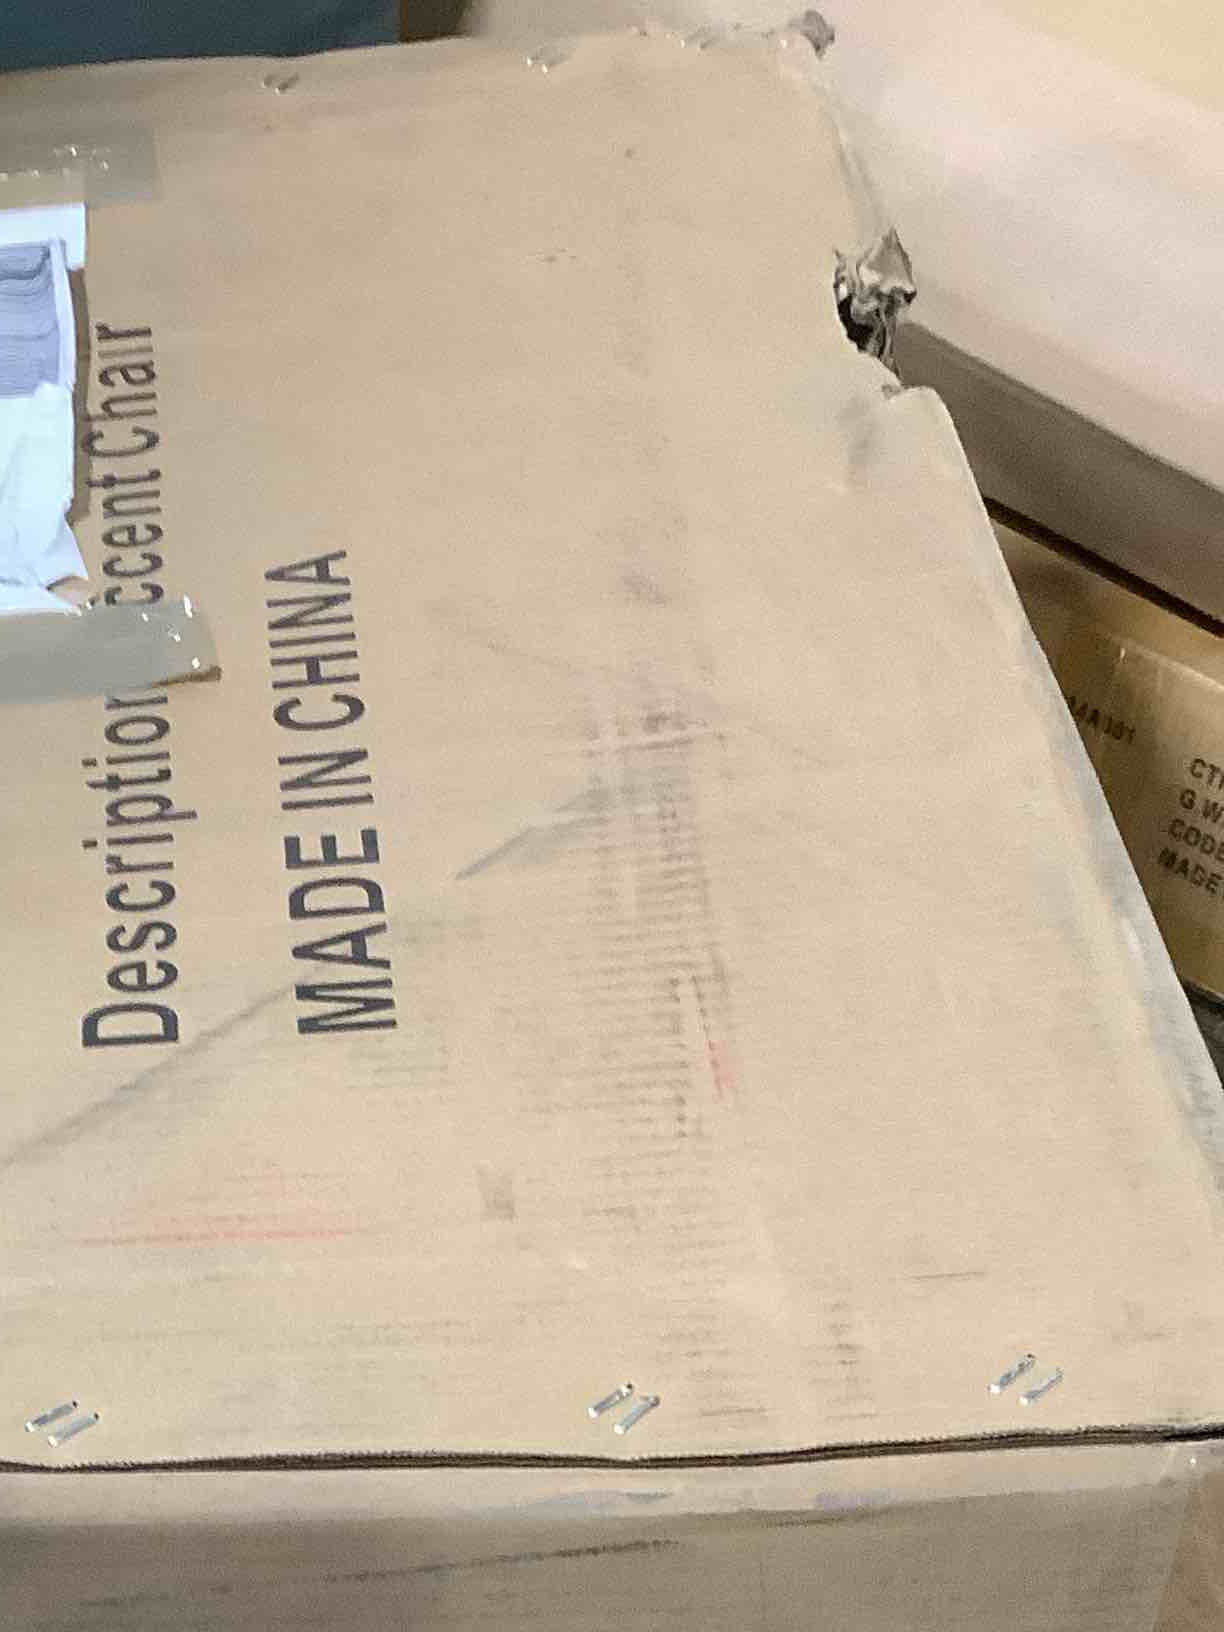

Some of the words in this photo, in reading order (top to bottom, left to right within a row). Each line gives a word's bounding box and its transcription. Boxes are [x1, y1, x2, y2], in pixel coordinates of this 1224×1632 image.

[82, 322, 161, 458] Chair
[85, 468, 164, 606] ccent
[264, 550, 366, 731] CHINA
[278, 748, 375, 811] IN
[284, 827, 398, 1035] MADE
[1159, 847, 1224, 894] MADE
